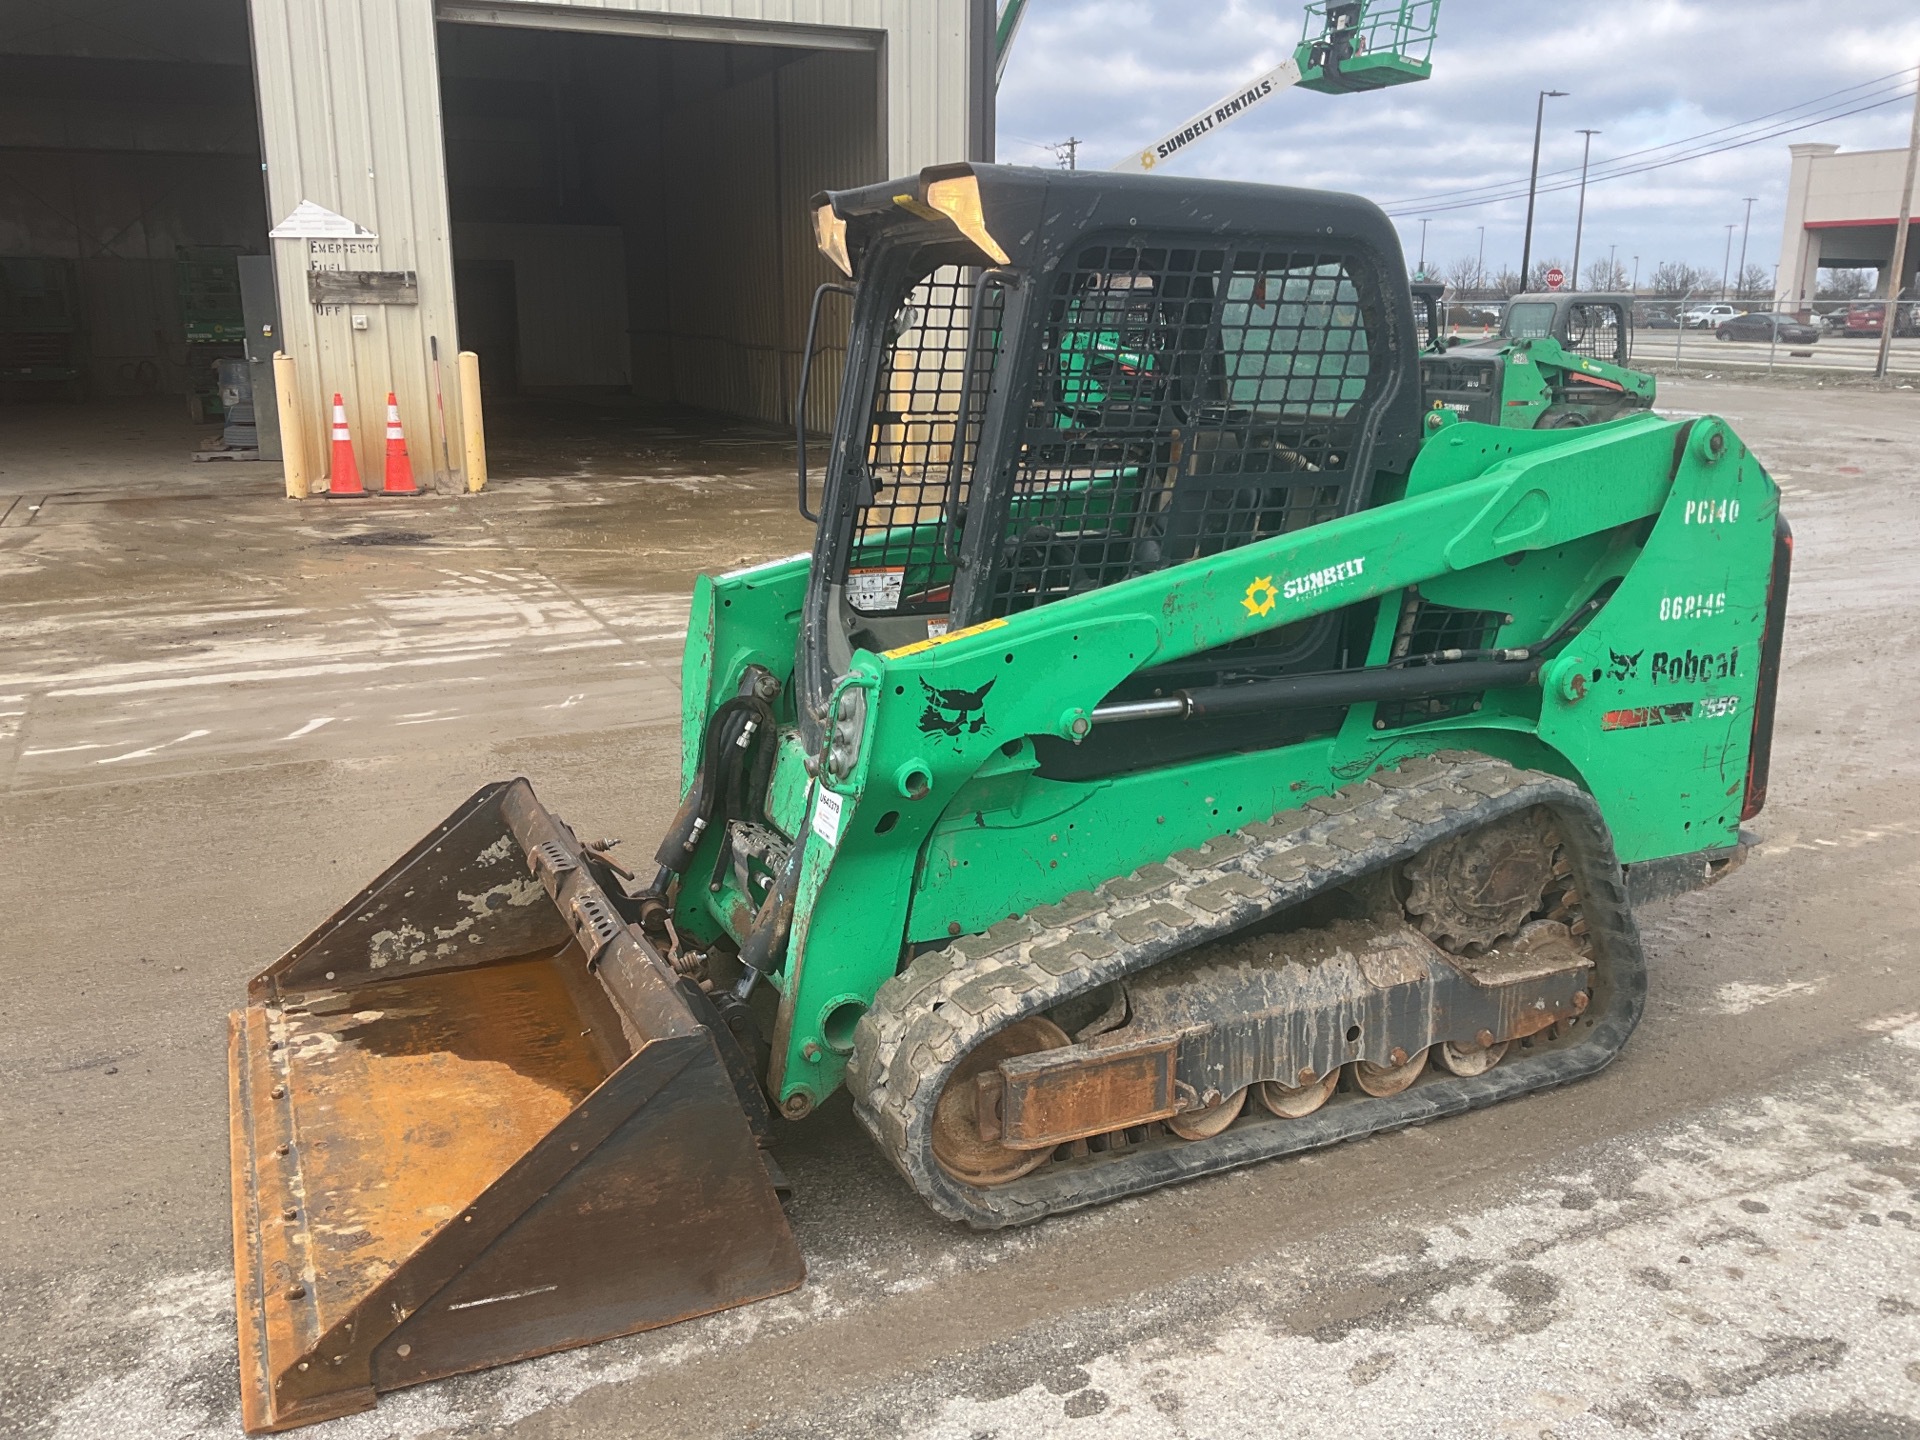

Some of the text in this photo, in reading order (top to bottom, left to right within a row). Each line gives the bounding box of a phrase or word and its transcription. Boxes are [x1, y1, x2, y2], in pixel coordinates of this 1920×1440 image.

[1157, 80, 1272, 159] SUNBELT RENTALS
[310, 240, 379, 254] EMERGENCY
[1547, 273, 1563, 281] STOP
[315, 303, 341, 316] OFF
[1684, 499, 1740, 525] PC140
[1283, 556, 1366, 599] SUNBELT
[1652, 645, 1739, 686] Bobcat
